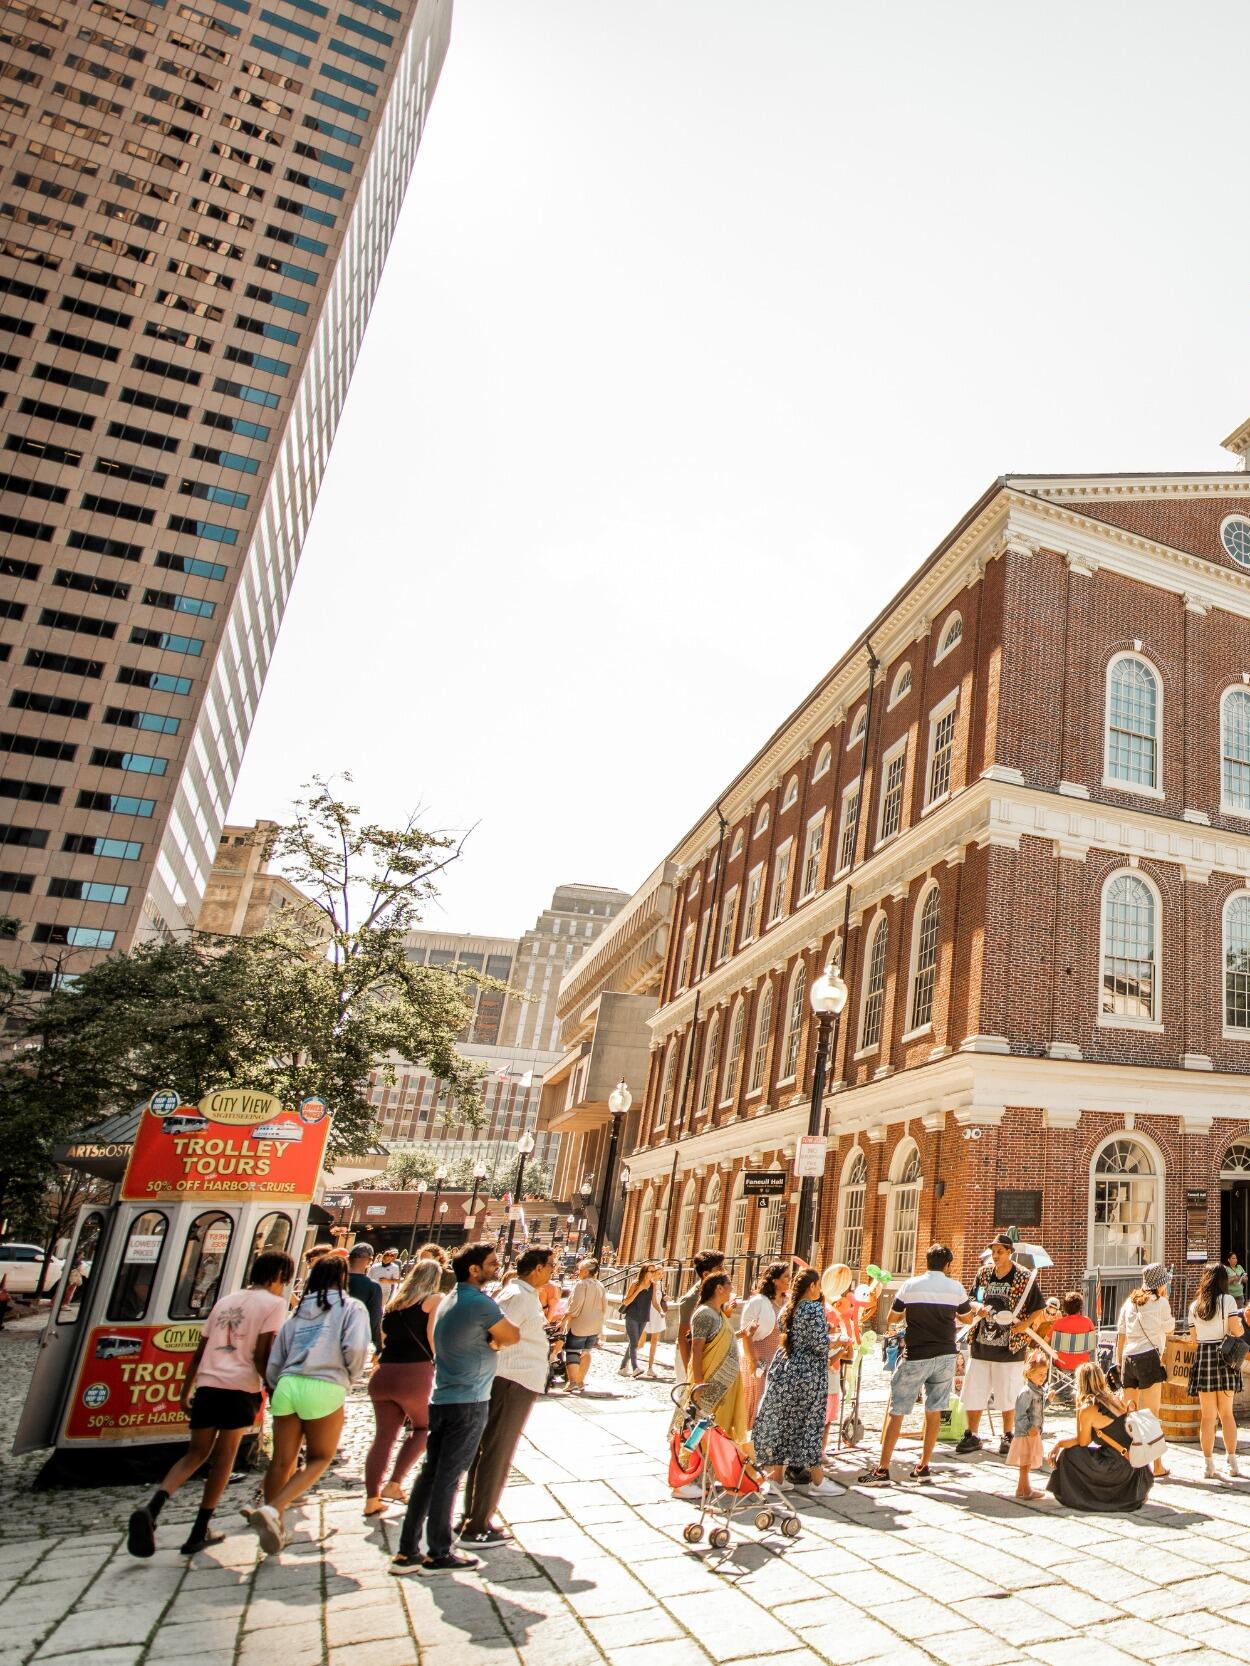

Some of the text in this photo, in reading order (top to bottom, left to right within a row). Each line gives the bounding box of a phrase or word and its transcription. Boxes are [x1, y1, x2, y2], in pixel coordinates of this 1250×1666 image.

[212, 1112, 264, 1120] SIGHTSEEING
[173, 1138, 290, 1158] TROLLEY
[182, 1157, 271, 1176] TOURS
[146, 1180, 296, 1192] 50% OFF HARBOR CRUISE
[128, 1240, 161, 1248] LOWEST
[1174, 1350, 1181, 1363] A
[87, 1415, 115, 1428] 50%
[118, 1414, 145, 1426] OFF
